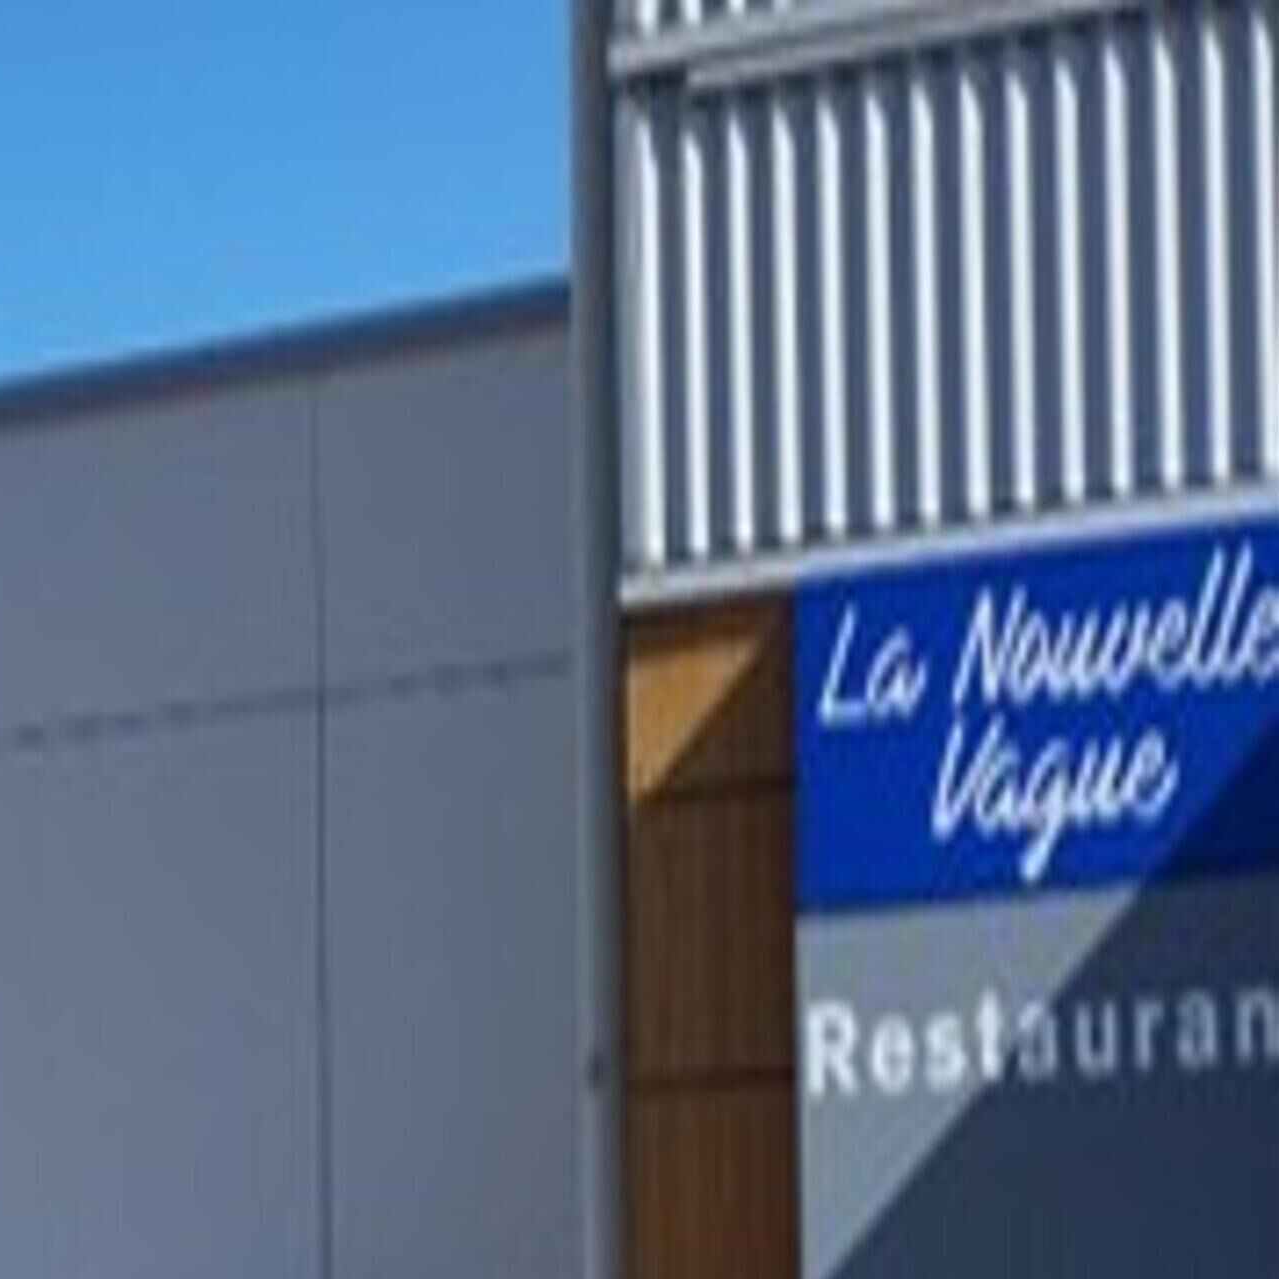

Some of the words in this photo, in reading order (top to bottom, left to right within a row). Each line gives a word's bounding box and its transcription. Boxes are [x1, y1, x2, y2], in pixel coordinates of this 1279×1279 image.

[817, 601, 927, 726] La
[951, 538, 1279, 705] Nouvelle
[931, 712, 1179, 880] Vague
[804, 986, 1279, 1095] Restauran
